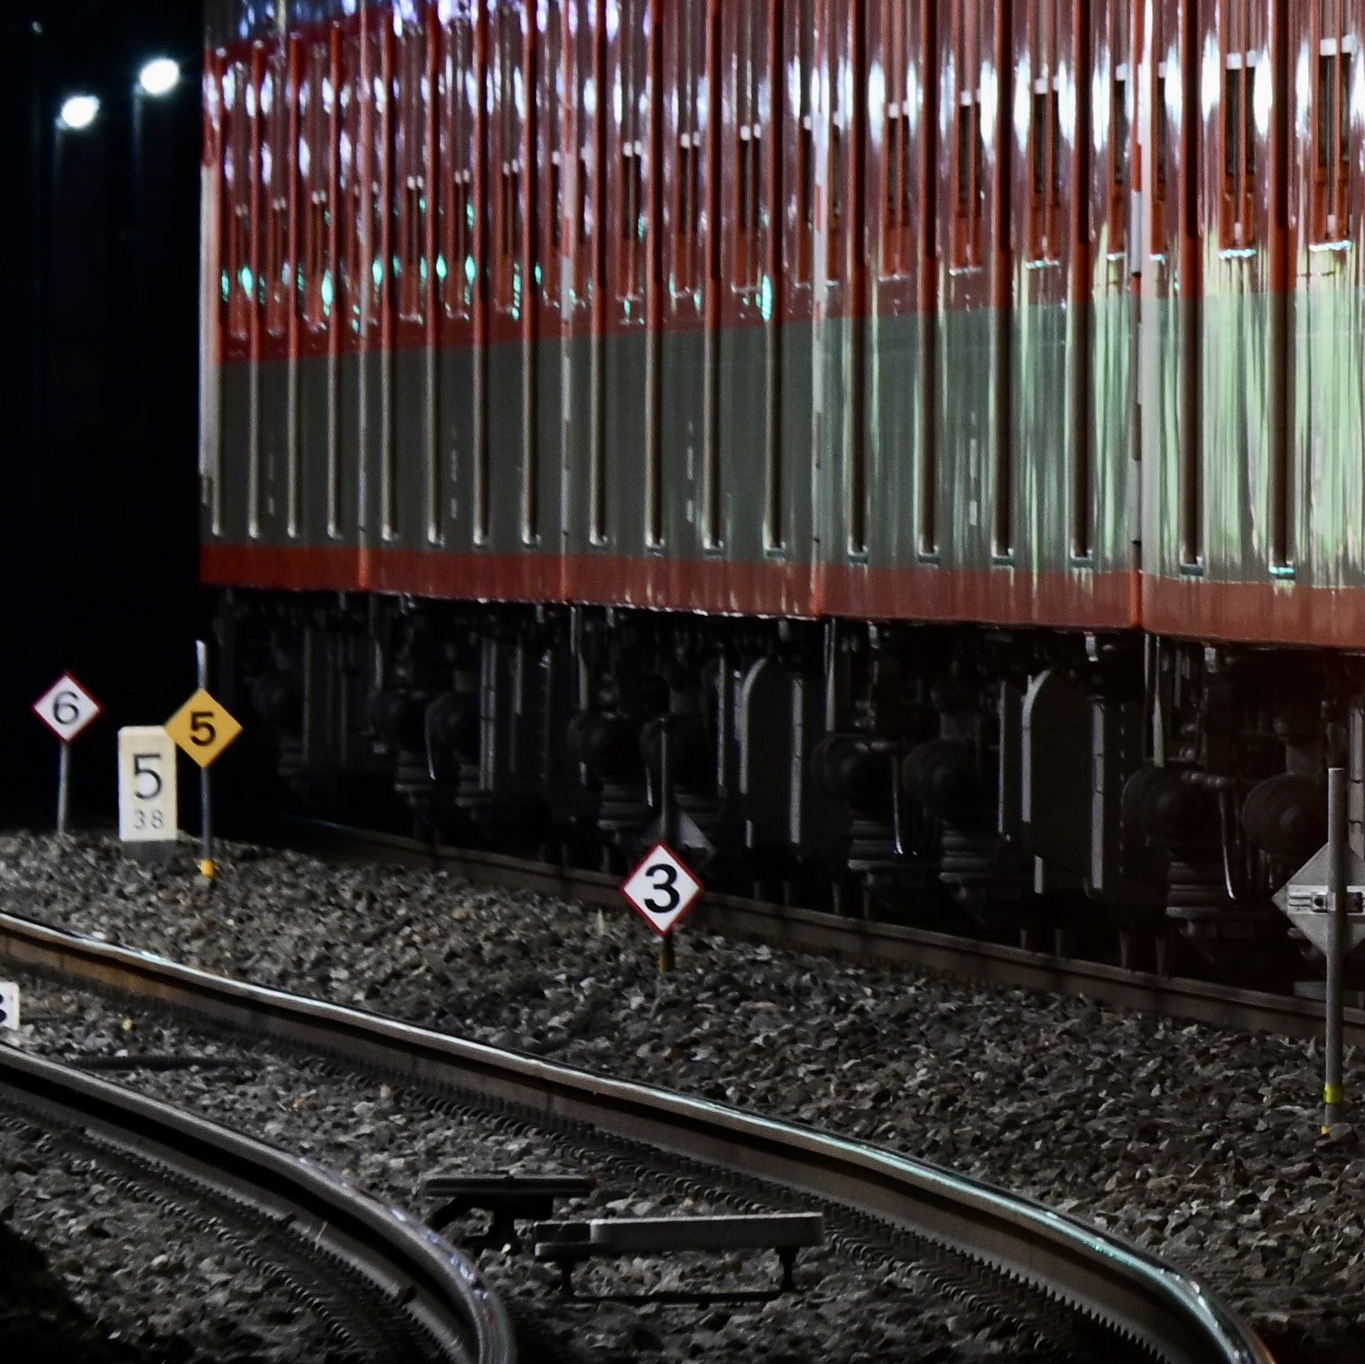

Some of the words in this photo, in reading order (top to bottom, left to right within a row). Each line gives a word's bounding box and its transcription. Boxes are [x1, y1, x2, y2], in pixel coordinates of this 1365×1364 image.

[53, 691, 79, 724] 6
[190, 711, 216, 746] 5
[133, 754, 161, 800] 5
[134, 809, 164, 829] 38
[644, 864, 680, 913] 3
